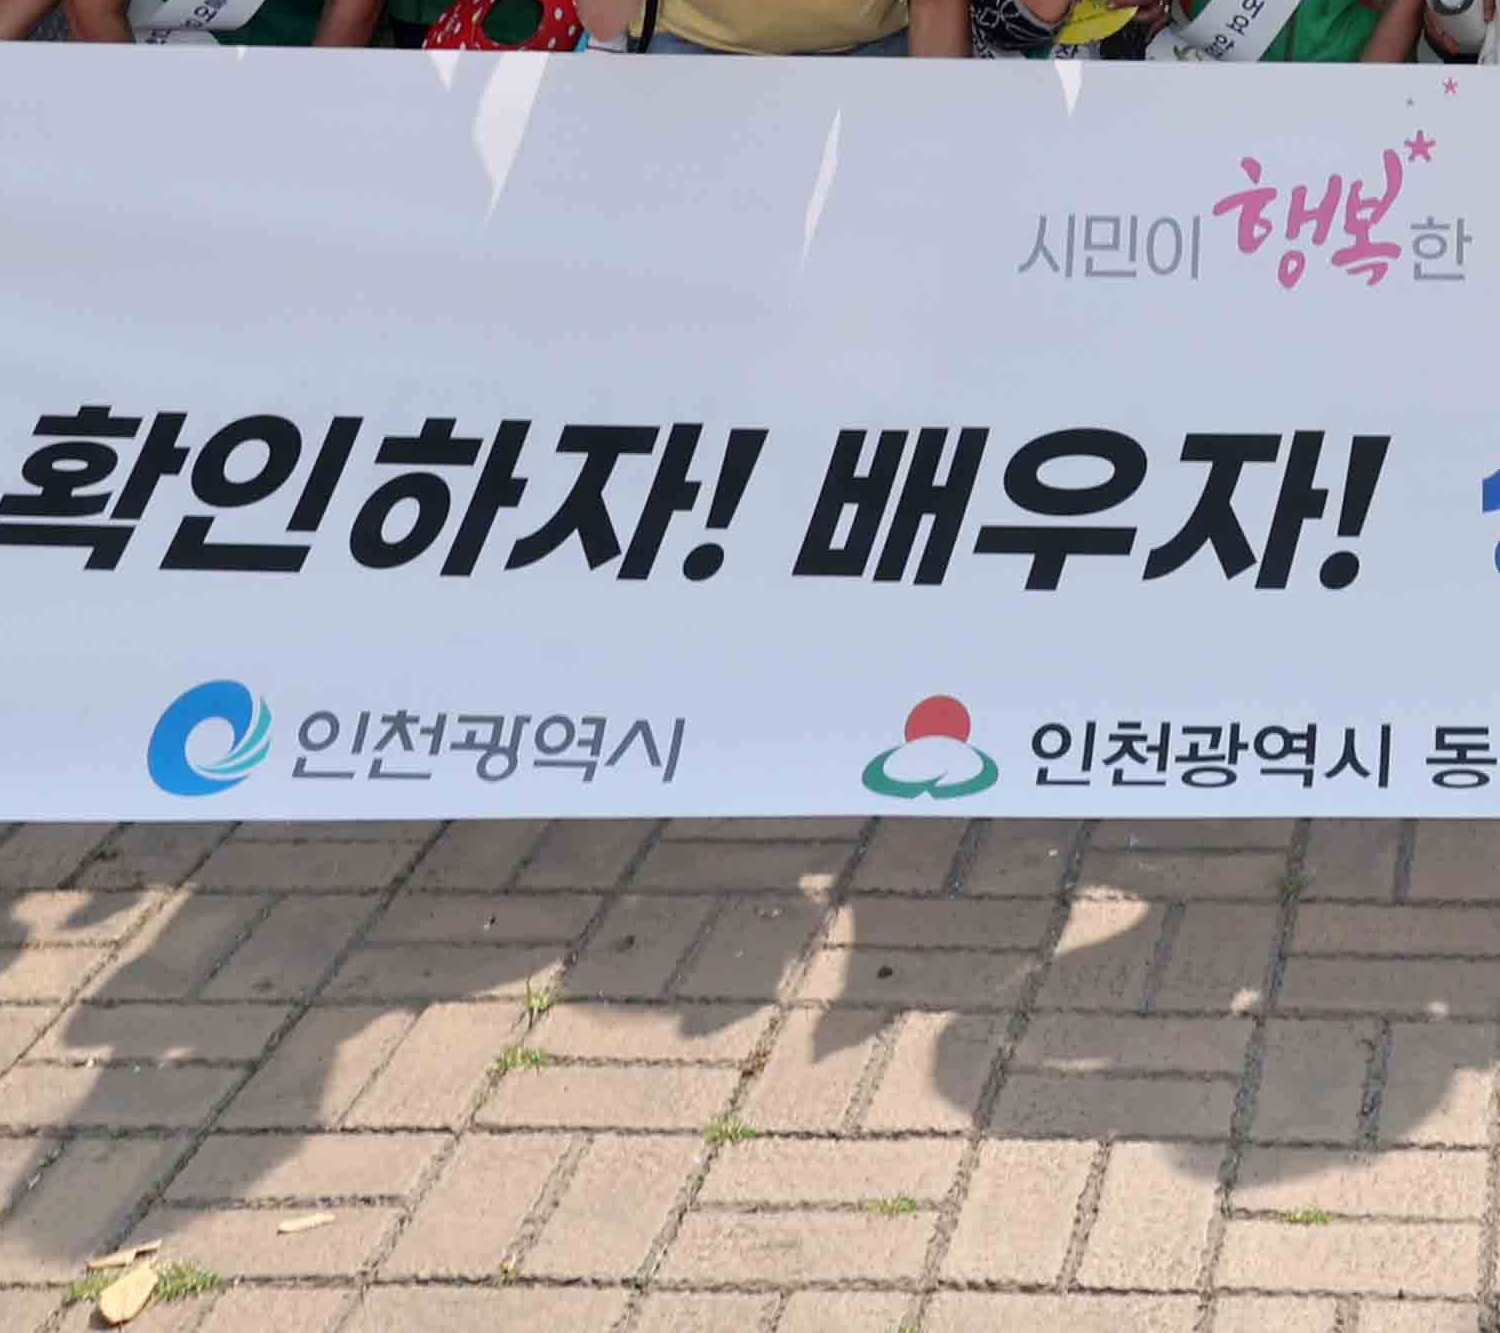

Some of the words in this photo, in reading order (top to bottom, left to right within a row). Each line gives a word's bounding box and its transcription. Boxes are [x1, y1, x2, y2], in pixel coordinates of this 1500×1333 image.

[1018, 214, 1200, 280] 시민이
[1213, 147, 1471, 289] 행복한
[792, 426, 1392, 591] 배우자!
[291, 709, 687, 783] 인천광역시
[1031, 720, 1392, 789] 인천광역시
